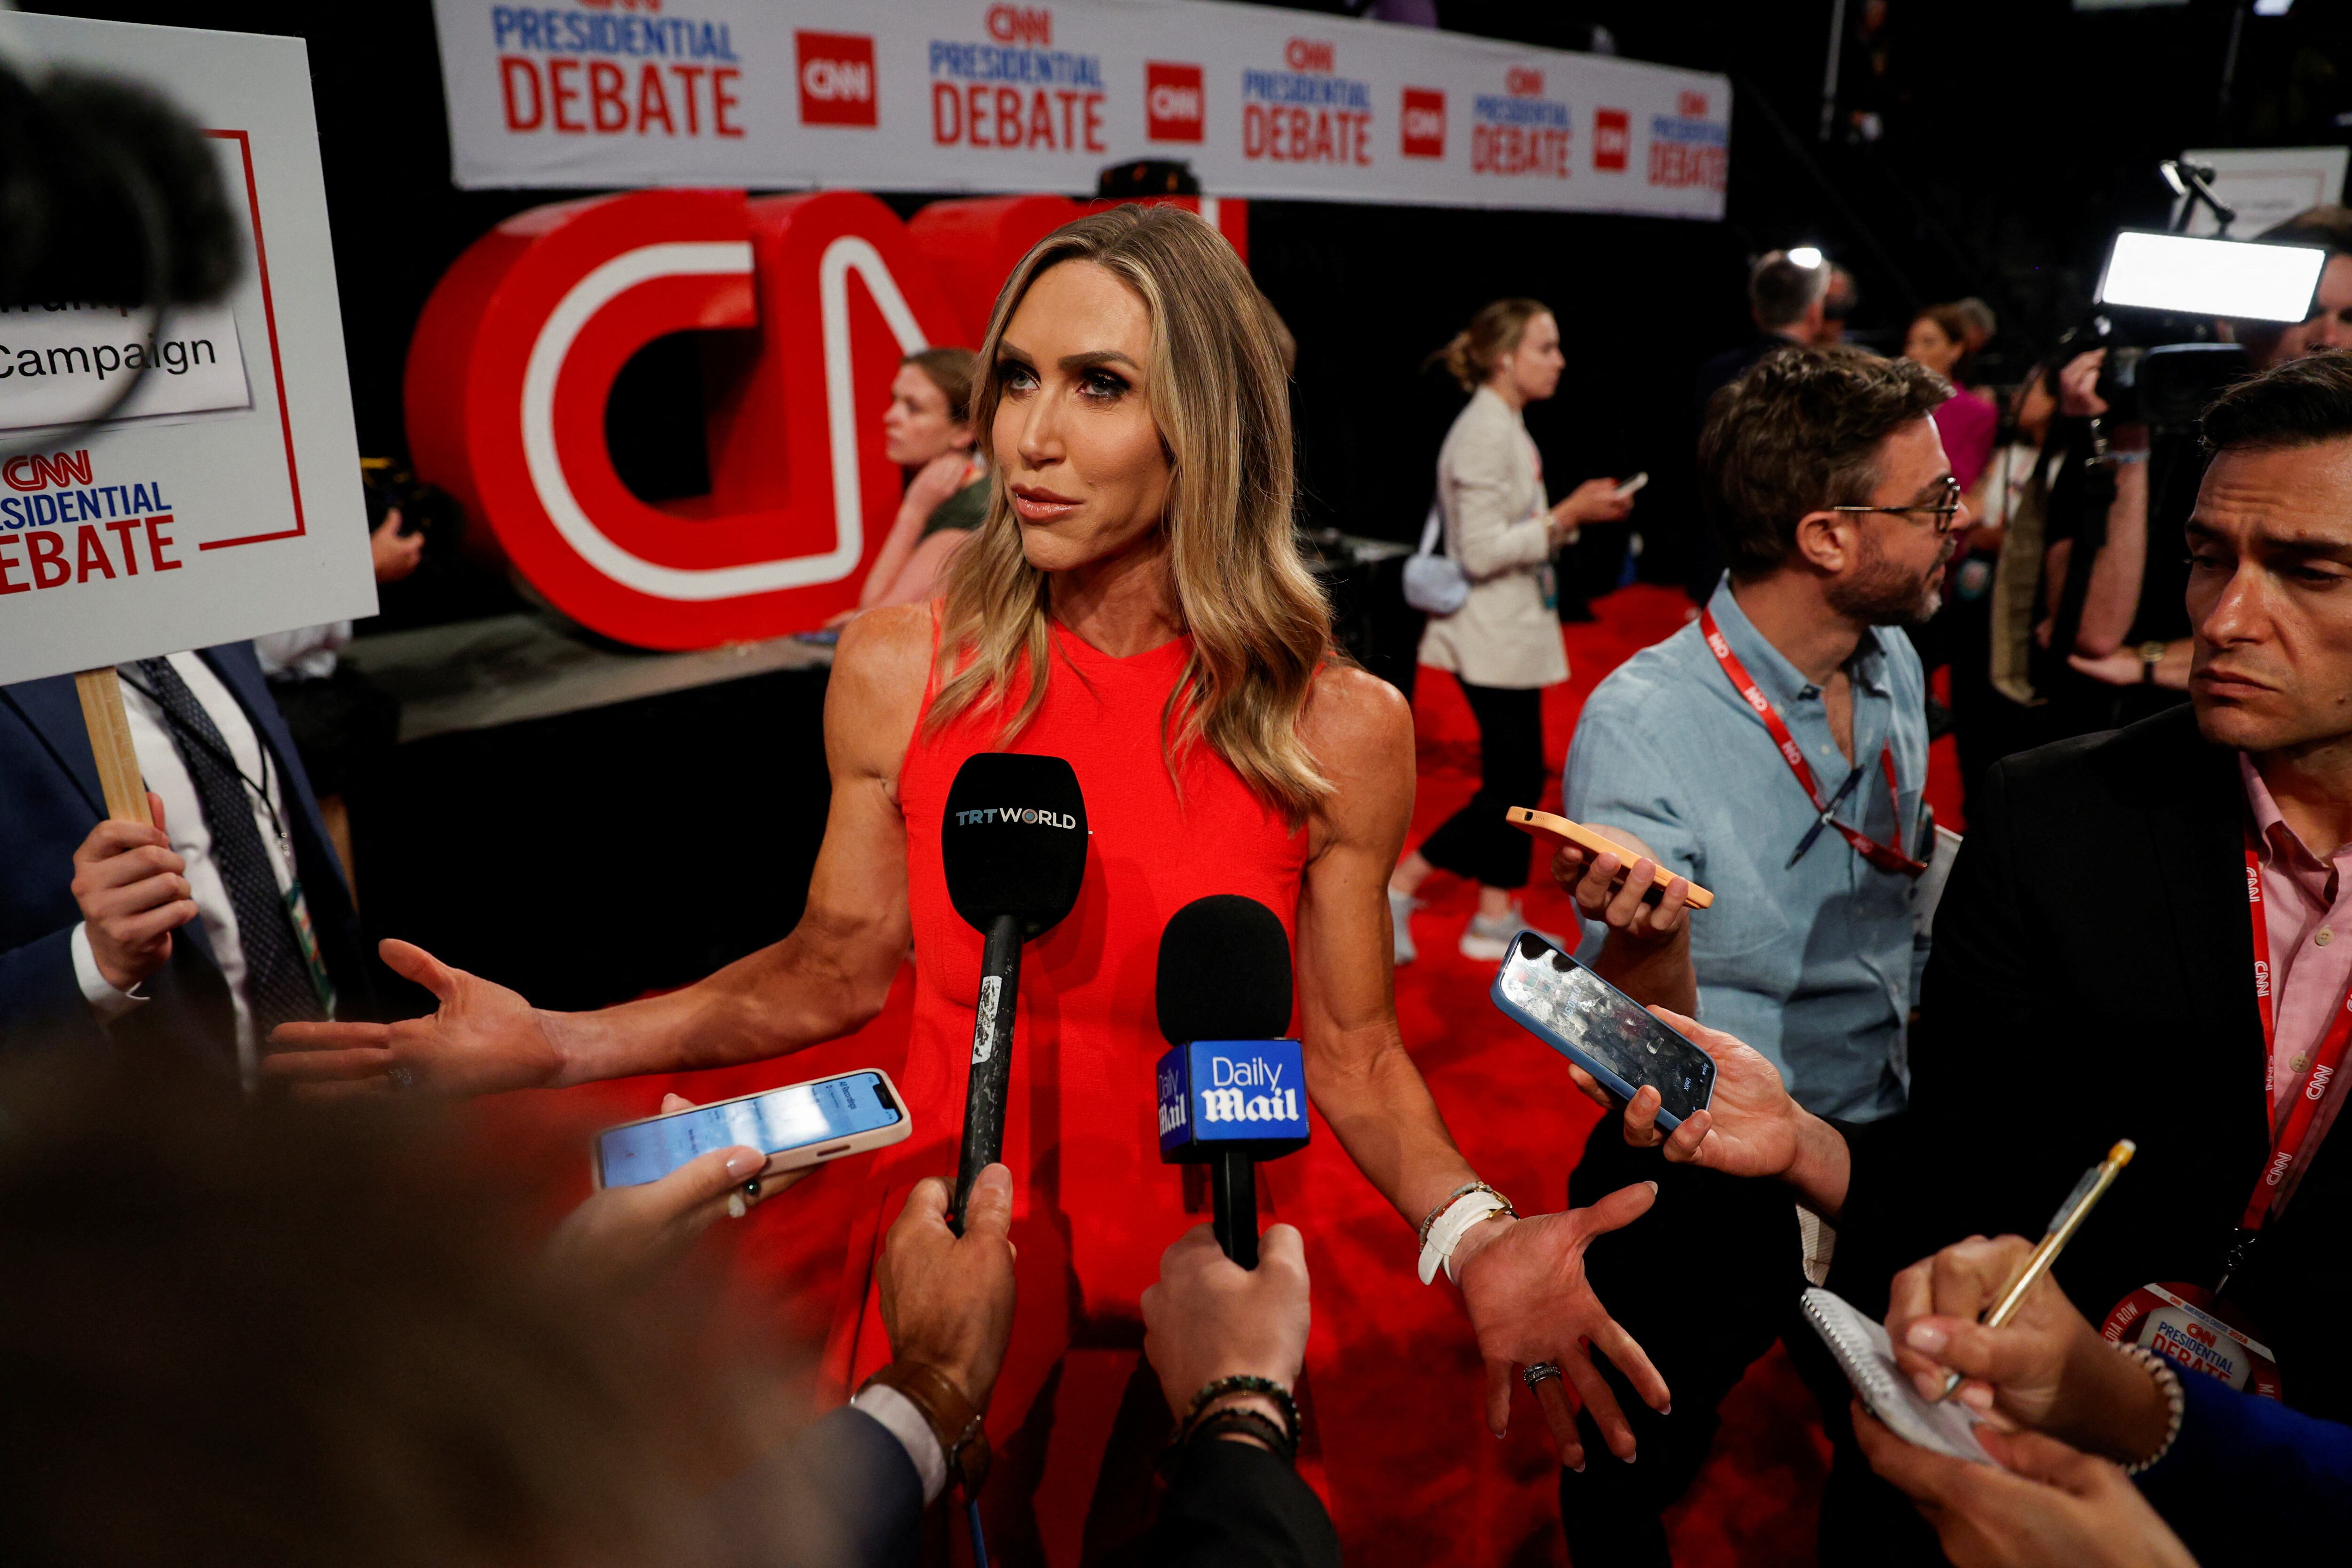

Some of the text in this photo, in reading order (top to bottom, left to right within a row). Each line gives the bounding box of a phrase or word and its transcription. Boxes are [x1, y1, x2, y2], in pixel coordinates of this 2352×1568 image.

[491, 6, 740, 63] PRESIDENTIAL
[987, 5, 1053, 46] CNN
[499, 55, 747, 139] DEBATE
[803, 58, 869, 103] CNN
[932, 82, 1108, 153] DEBATE
[1243, 103, 1373, 166] DEBATE
[2, 450, 93, 491] CNN
[955, 808, 1076, 829] TRT WORLD
[2255, 961, 2269, 997] CNN
[1212, 1056, 1283, 1092] Daily
[2306, 1064, 2333, 1100] CNN
[1200, 1087, 1300, 1123] Mail
[2266, 1152, 2292, 1185] CNN
[2116, 1301, 2138, 1323] ROW
[2158, 1321, 2233, 1374] PRESIDENTIAL
[2186, 1323, 2217, 1347] CNN
